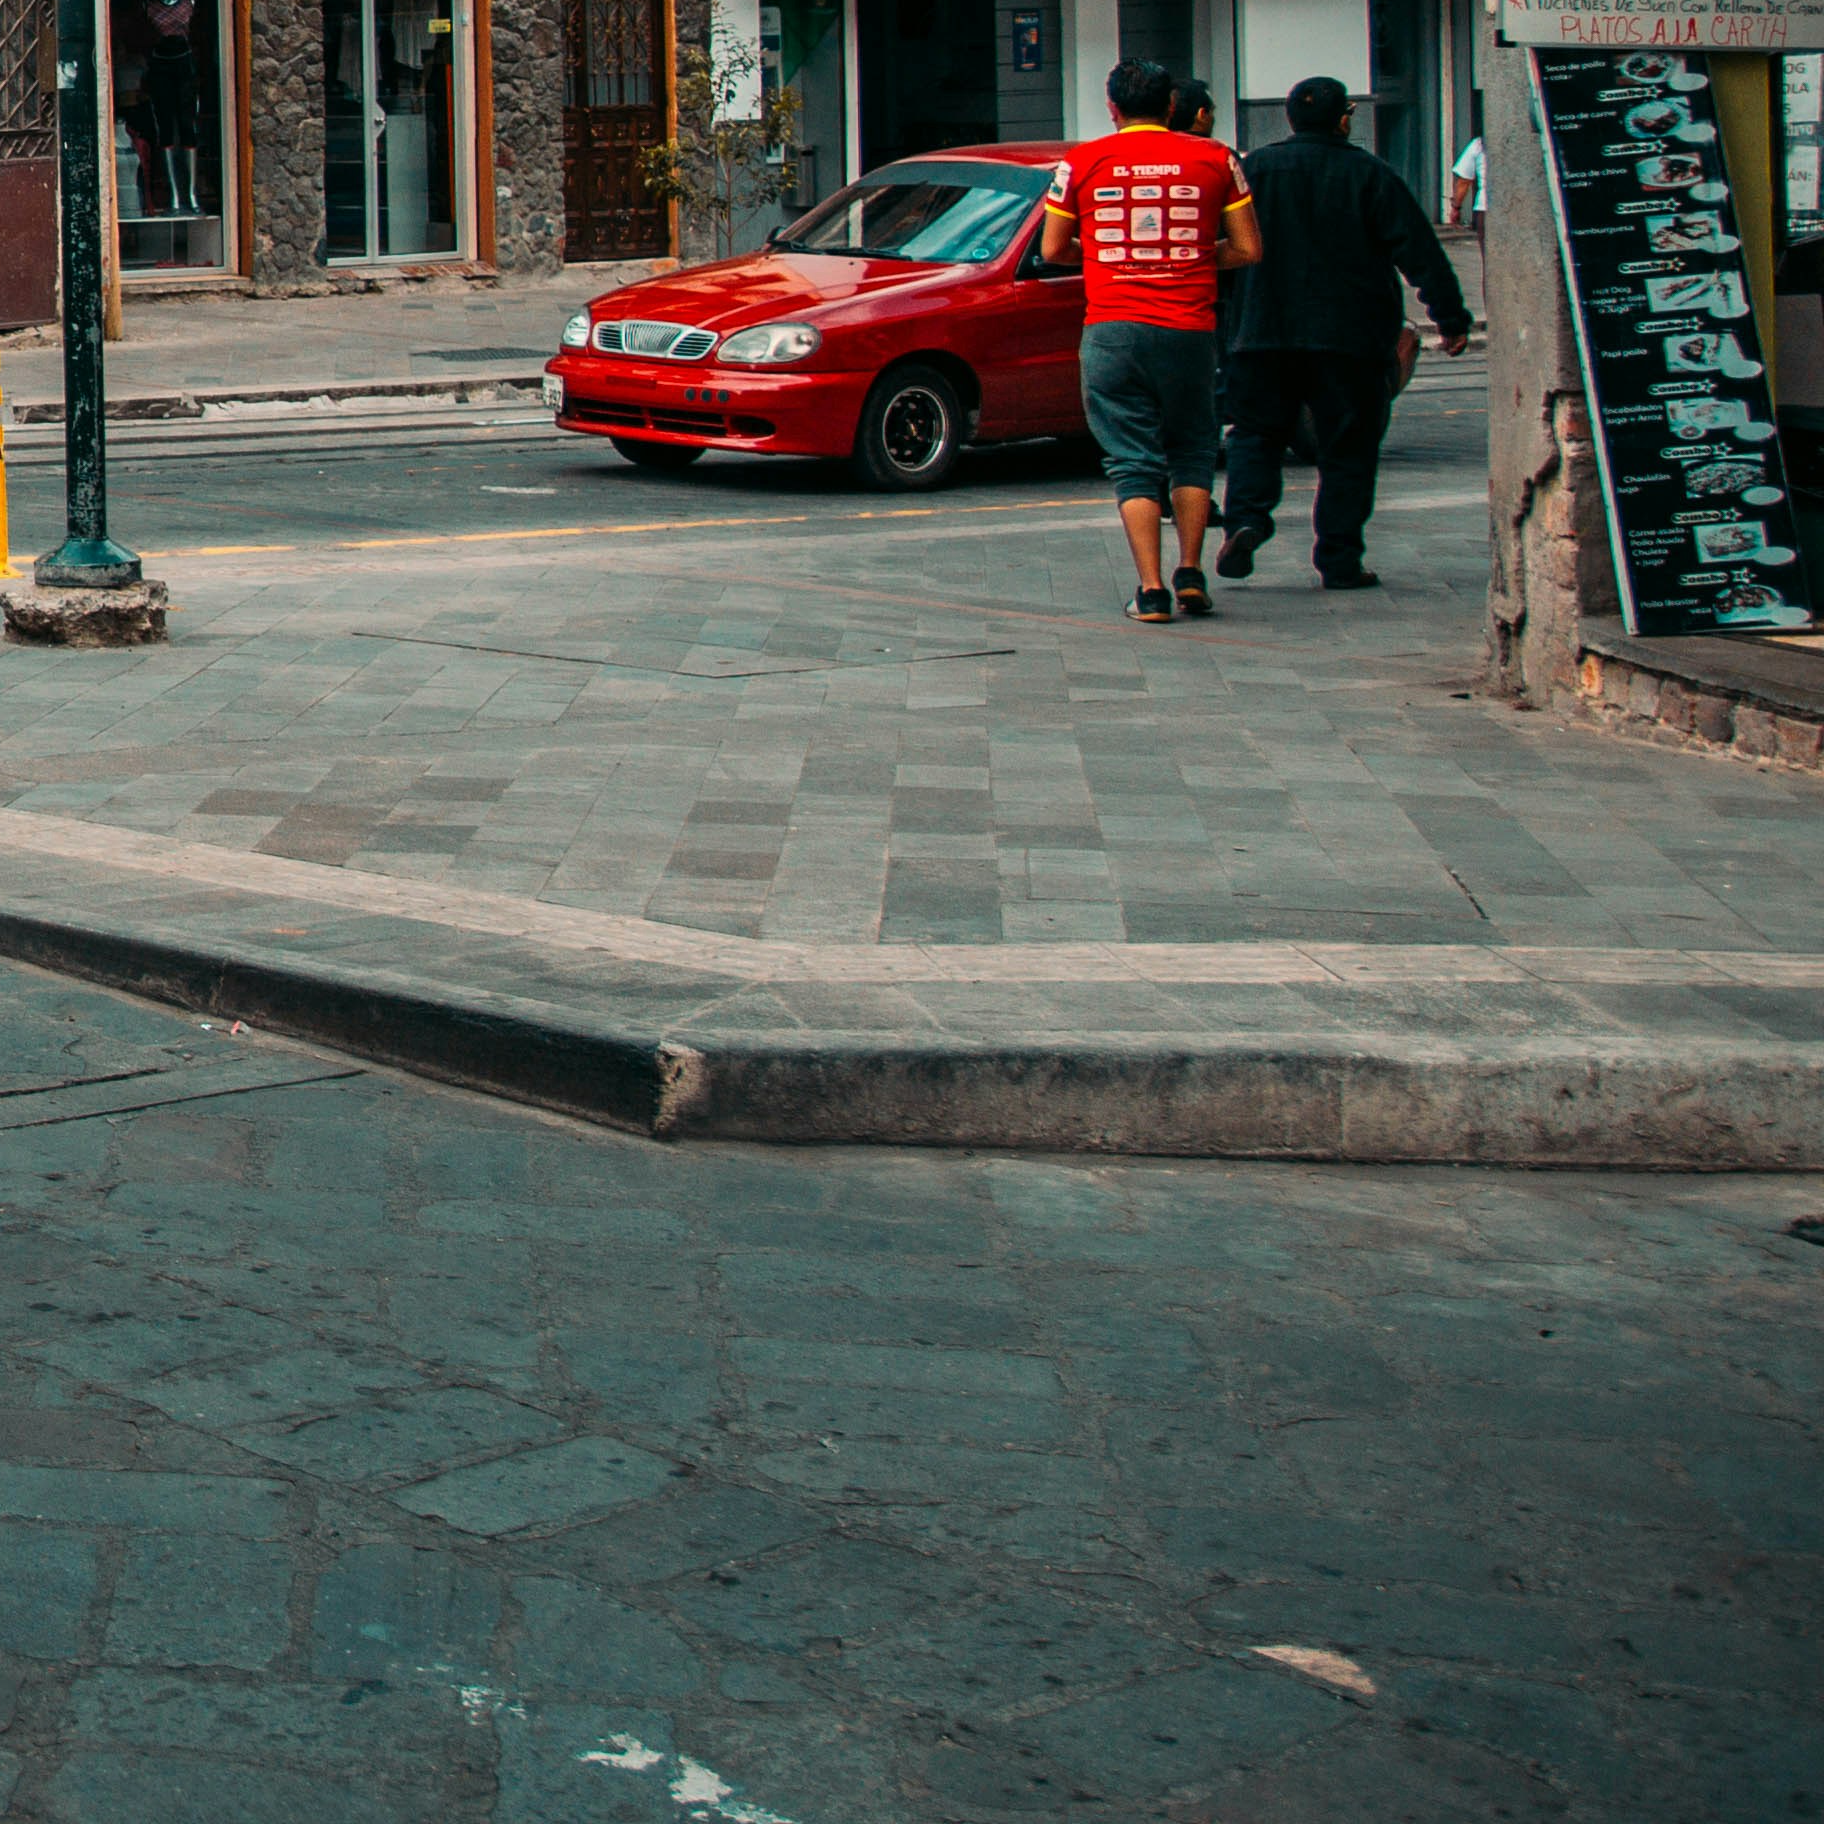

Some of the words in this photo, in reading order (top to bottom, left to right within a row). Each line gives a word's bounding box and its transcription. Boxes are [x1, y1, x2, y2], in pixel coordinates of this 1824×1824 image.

[1559, 14, 1644, 45] PLATOS
[1131, 163, 1181, 177] TIEMPO
[1649, 383, 1699, 395] Combo
[1661, 446, 1712, 458] Combo
[1672, 510, 1722, 523] Combo
[1679, 572, 1729, 585] Combo
